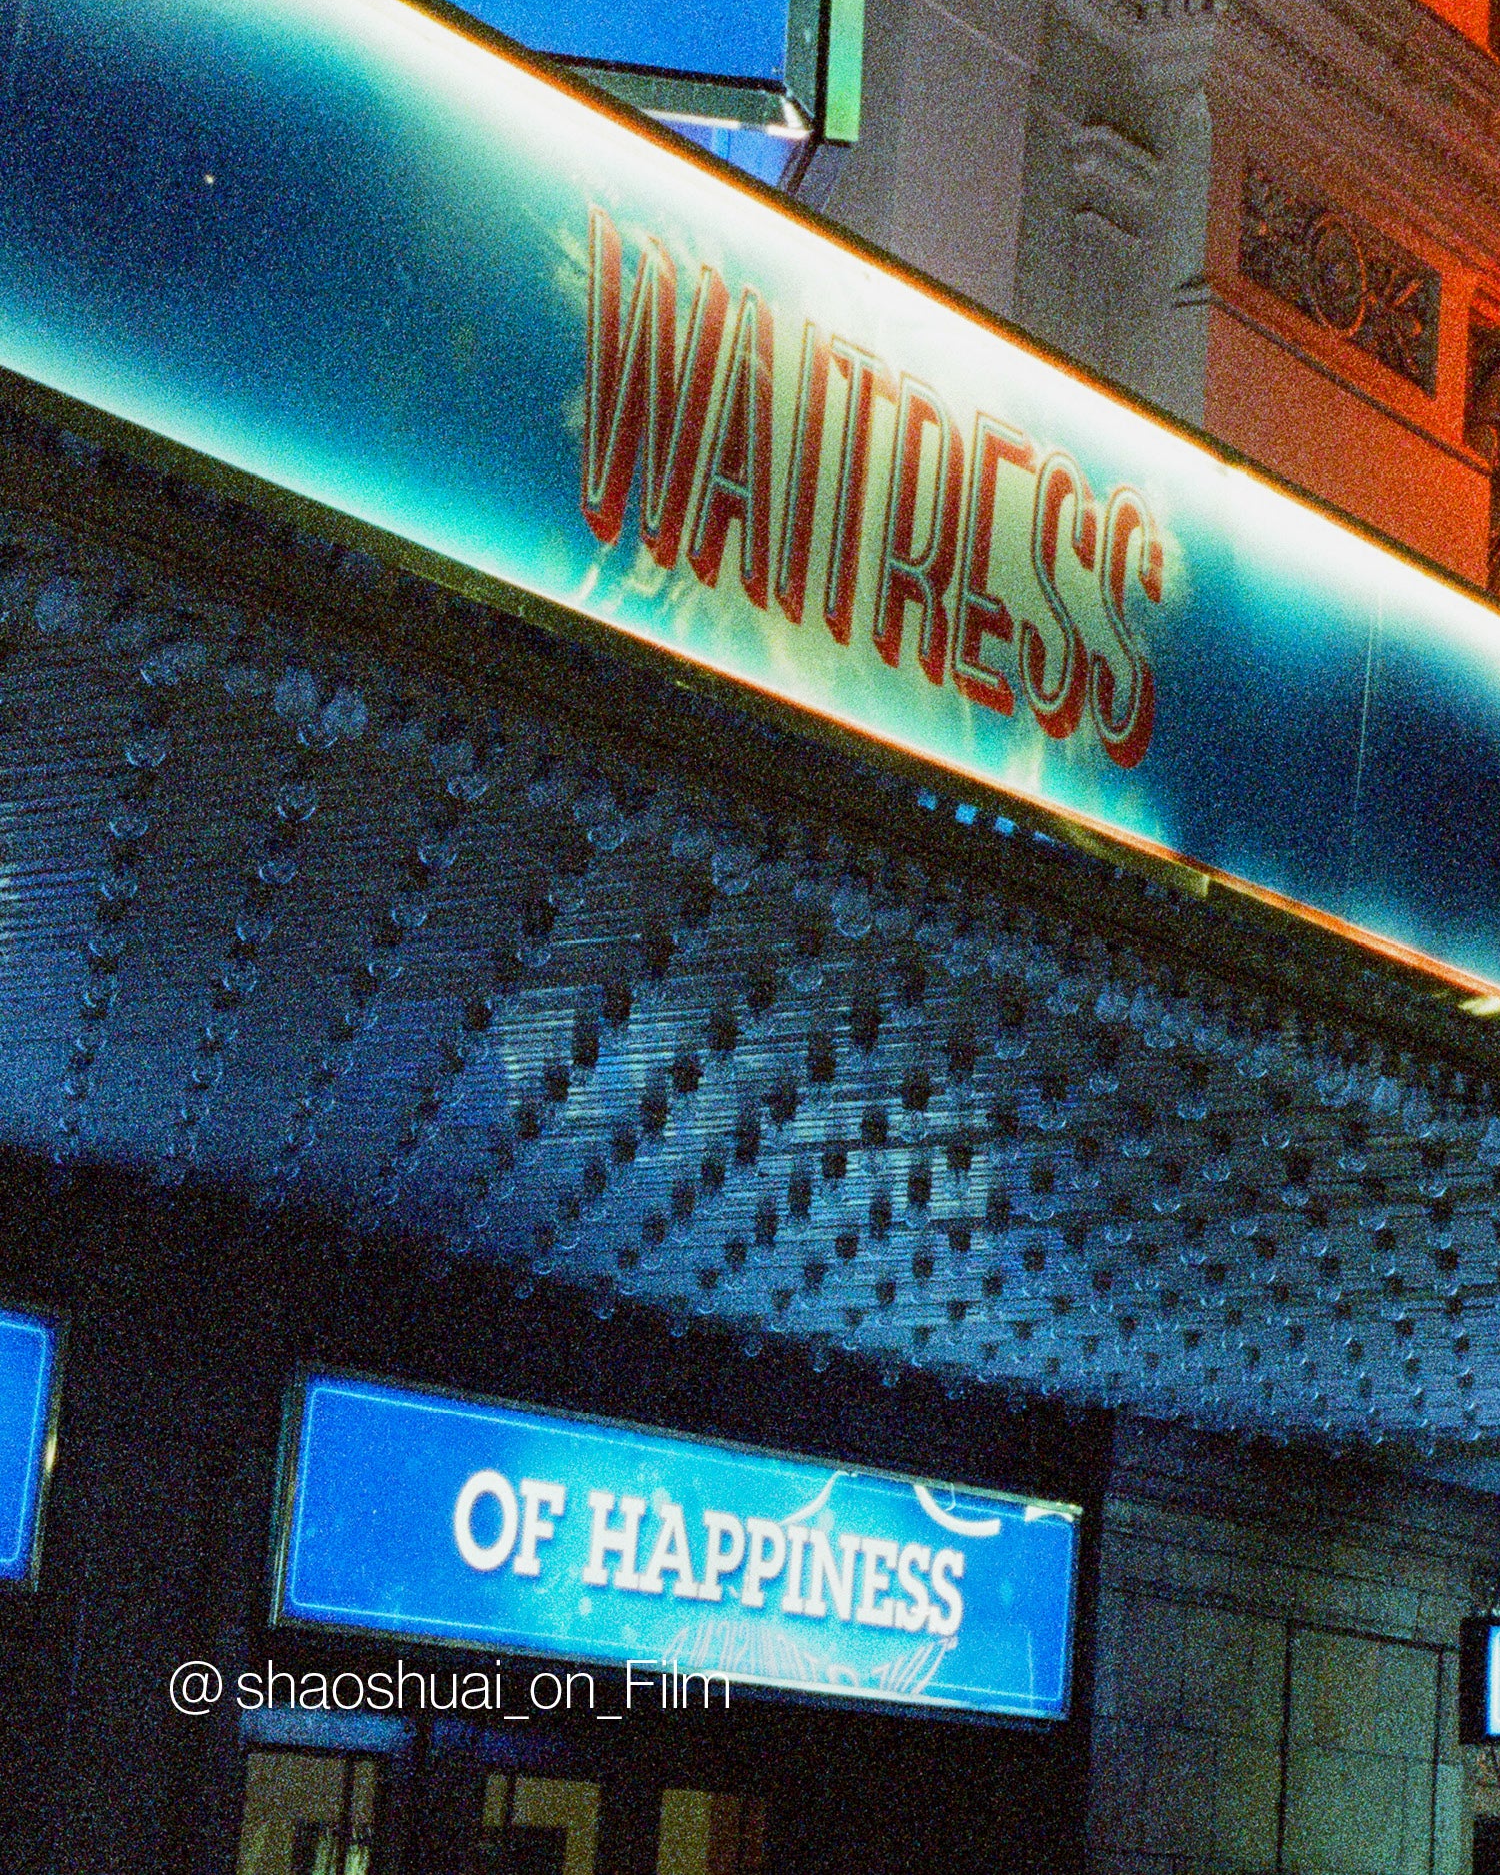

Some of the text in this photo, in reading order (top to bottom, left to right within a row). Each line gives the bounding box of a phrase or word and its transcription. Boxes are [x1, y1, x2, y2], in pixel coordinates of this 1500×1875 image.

[580, 204, 1164, 769] WAITRESS
[453, 1469, 966, 1636] OF HAPPINESS
